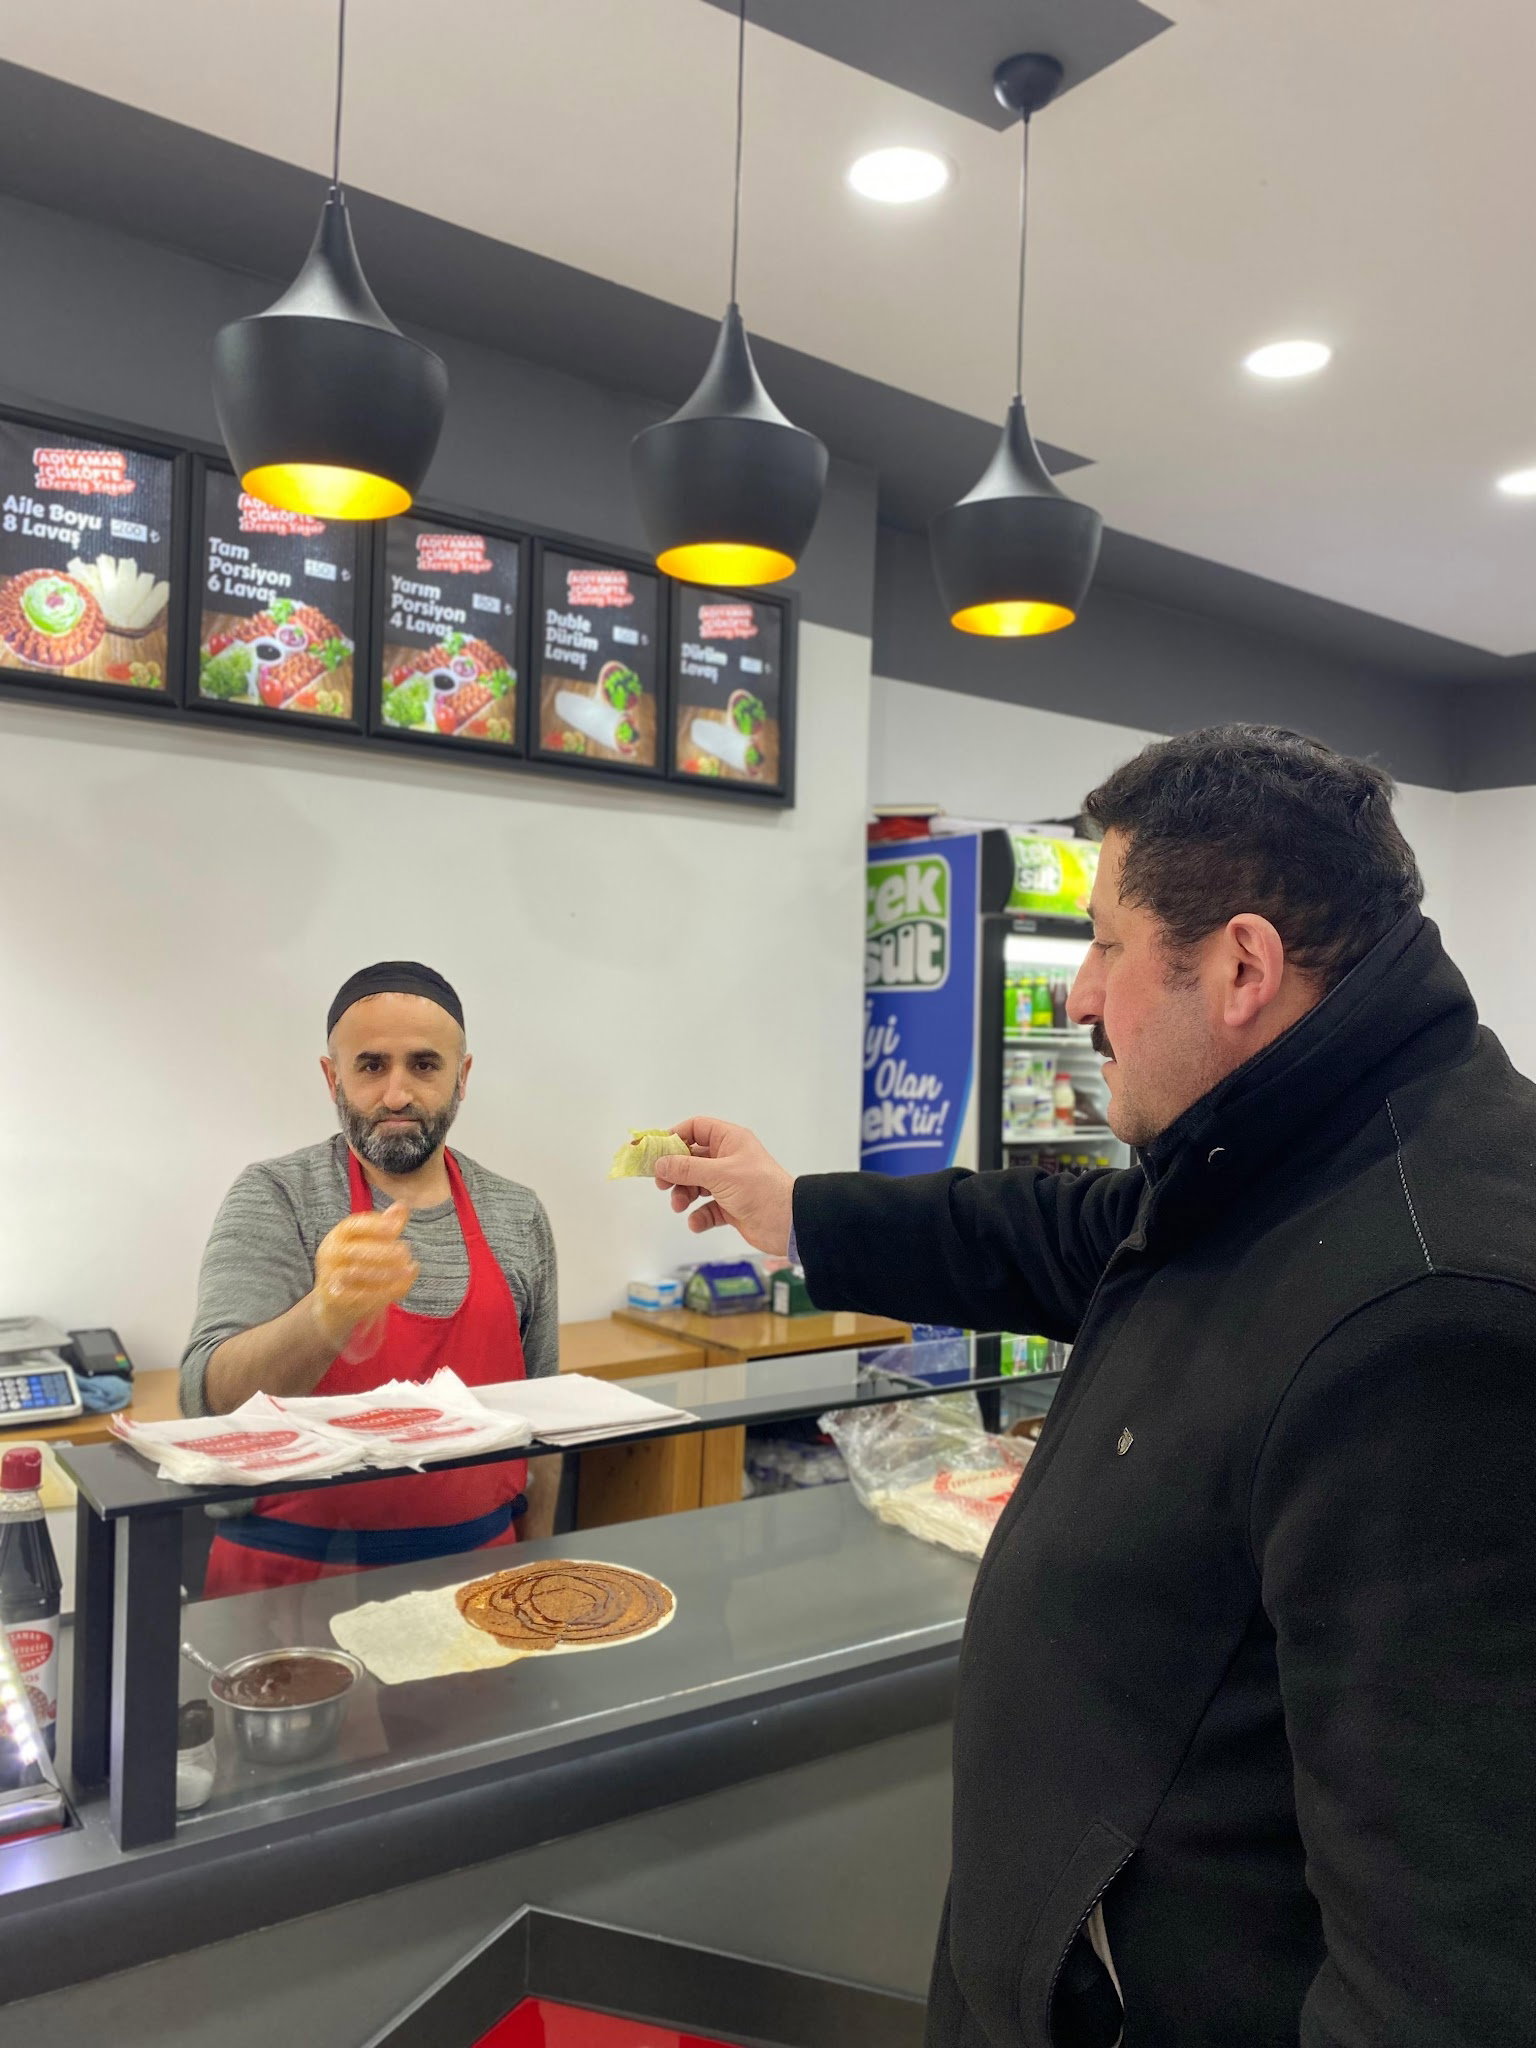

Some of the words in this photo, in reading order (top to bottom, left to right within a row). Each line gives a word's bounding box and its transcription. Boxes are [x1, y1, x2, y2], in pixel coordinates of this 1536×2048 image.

[3, 495, 44, 518] Aile
[50, 504, 102, 531] Boyu
[3, 514, 17, 532] 8
[22, 518, 81, 550] Lavaş
[209, 536, 250, 561] Tam
[207, 574, 221, 591] 6
[208, 556, 291, 588] Porsiyon
[391, 574, 441, 600] Yarım
[389, 611, 402, 628] 4
[391, 593, 466, 623] Porsiyon
[546, 609, 591, 634] Duble
[545, 626, 599, 652] Dürüm
[545, 643, 587, 671] Lavaş
[874, 1058, 943, 1100] Olan
